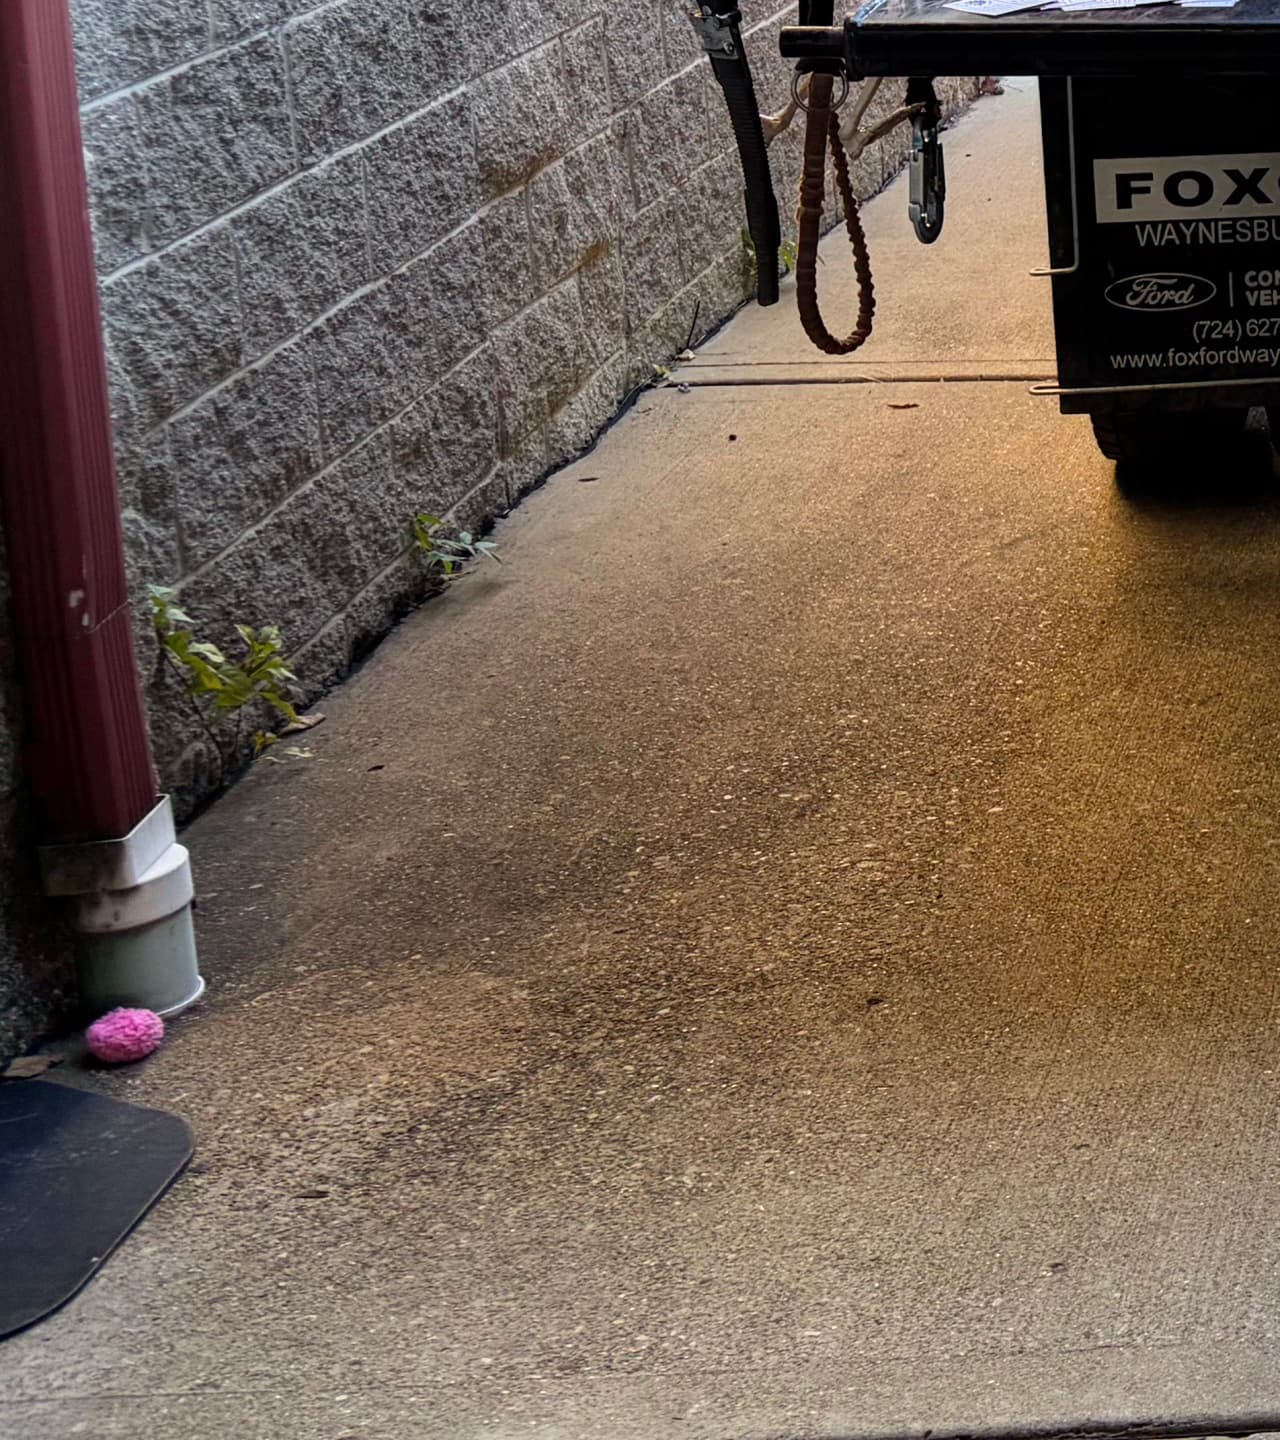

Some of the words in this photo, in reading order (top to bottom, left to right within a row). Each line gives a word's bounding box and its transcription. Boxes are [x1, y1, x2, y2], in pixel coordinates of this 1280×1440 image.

[1115, 168, 1273, 210] FOX
[1124, 276, 1196, 306] Ford
[1192, 319, 1242, 343] (724)
